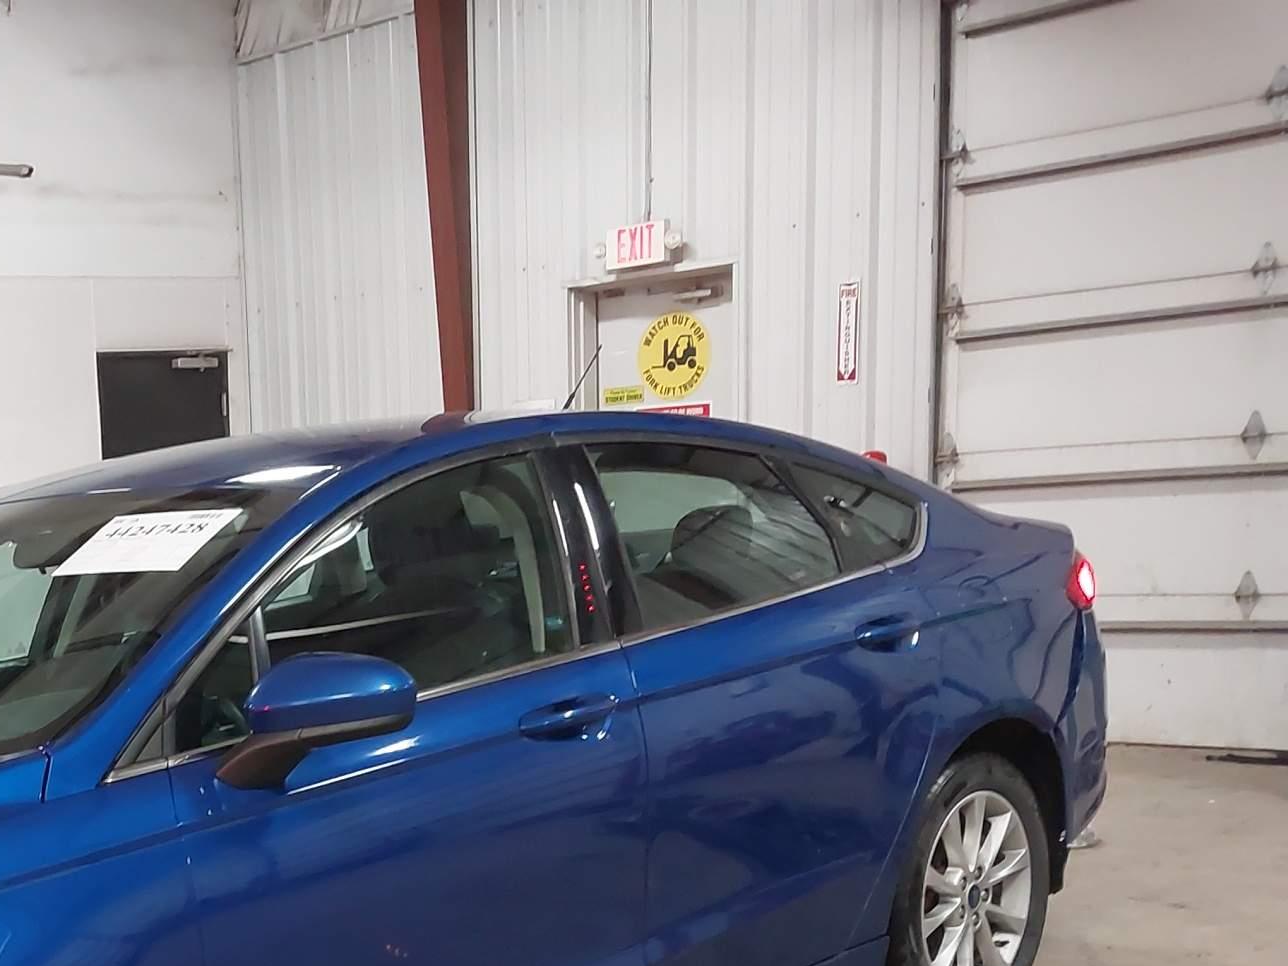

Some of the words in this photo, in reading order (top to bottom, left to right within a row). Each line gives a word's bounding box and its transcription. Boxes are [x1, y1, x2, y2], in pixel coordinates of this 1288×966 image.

[617, 223, 655, 264] EXIT
[840, 288, 857, 298] FIRE
[643, 316, 669, 347] WATCH
[672, 314, 689, 327] OUT
[689, 321, 705, 342] FOR
[643, 368, 660, 393] FORK
[659, 384, 676, 396] LIFT
[678, 365, 705, 395] TRUCKS
[106, 522, 209, 538] 44247428
